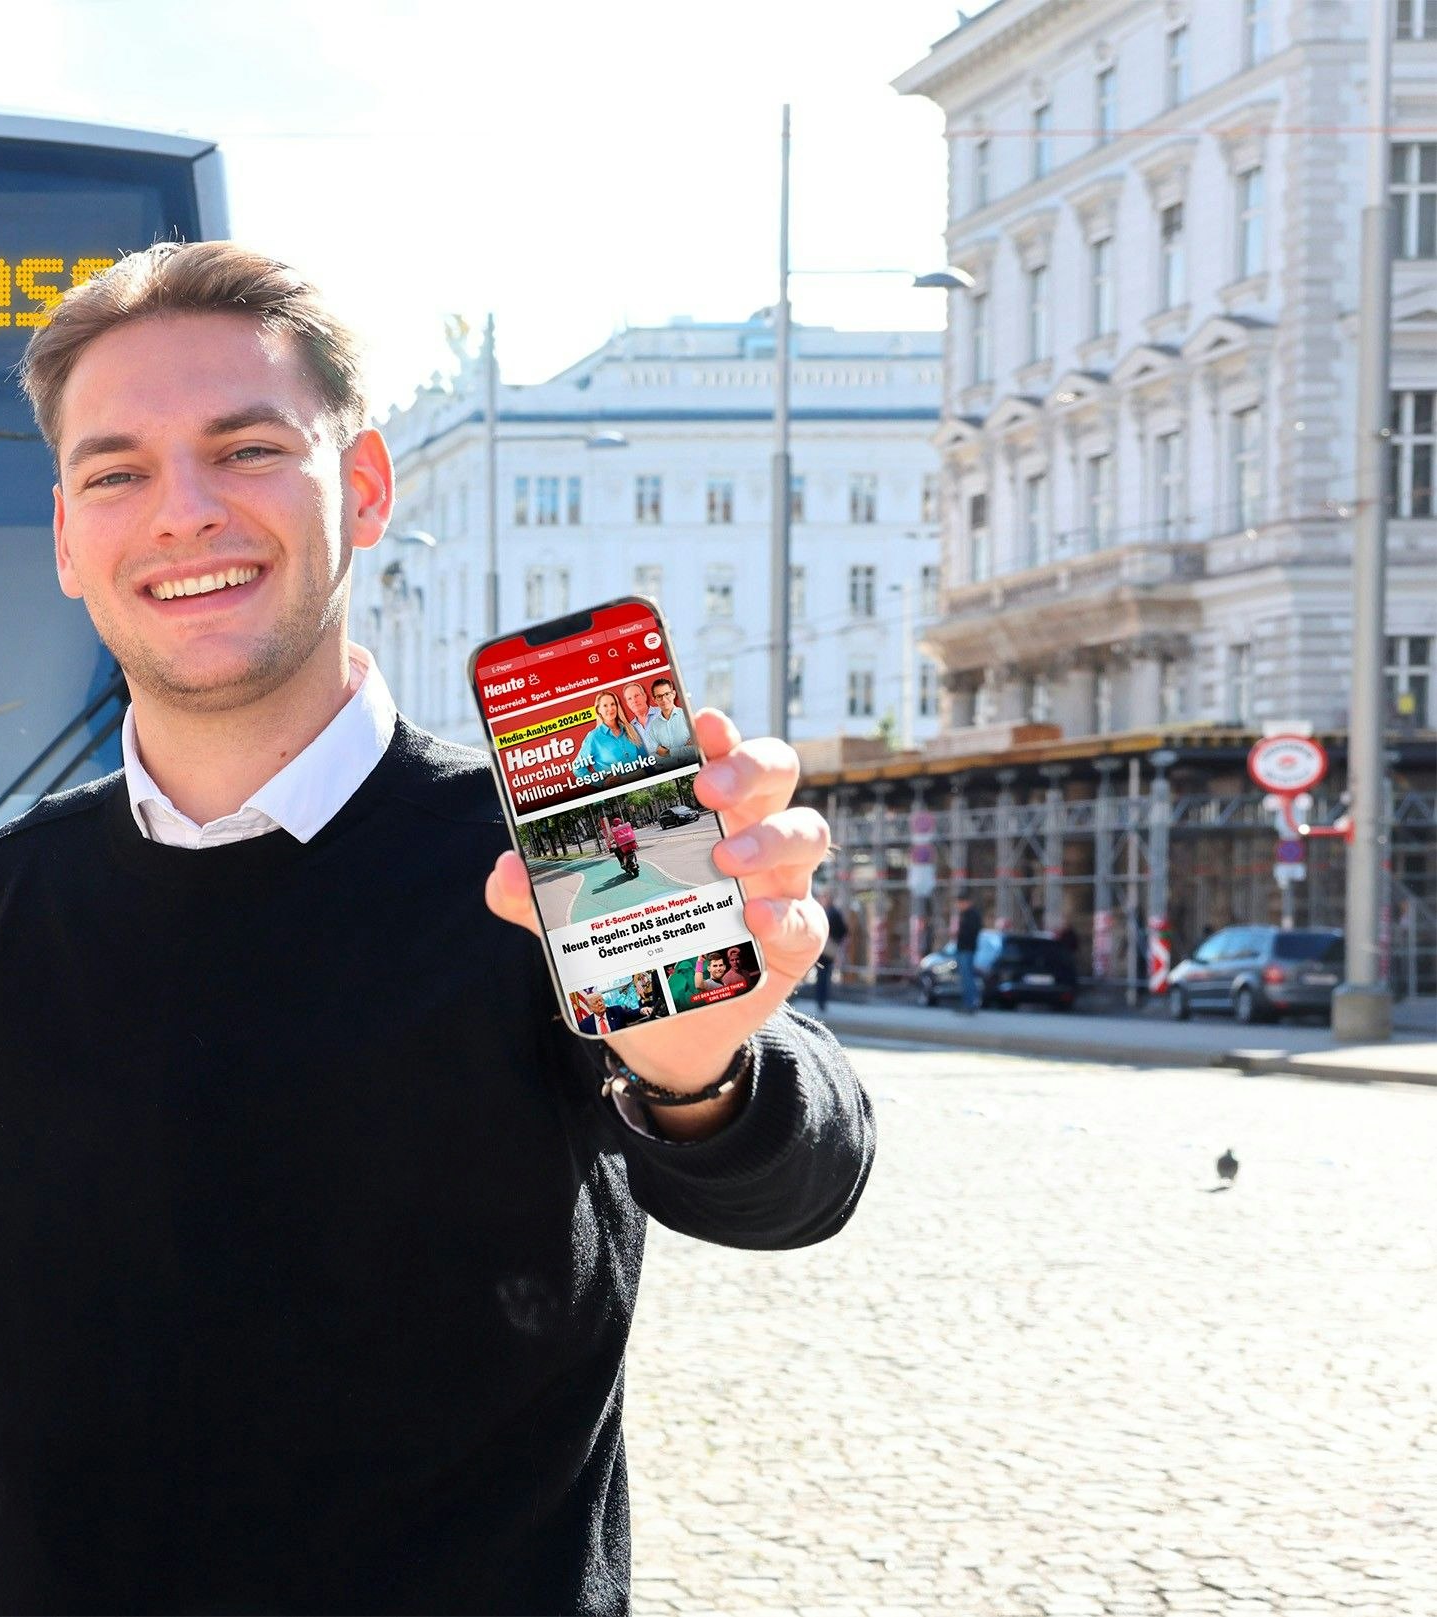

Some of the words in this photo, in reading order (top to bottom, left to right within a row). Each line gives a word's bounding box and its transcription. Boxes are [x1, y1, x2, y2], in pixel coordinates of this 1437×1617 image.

[631, 657, 661, 671] Neueste
[483, 676, 525, 698] Heute
[488, 696, 527, 714] Österreich
[531, 690, 552, 702] Sport
[555, 676, 599, 694] Nachrichten
[499, 723, 557, 746] Media-Analyse
[558, 711, 592, 728] 2024/25
[505, 736, 575, 772] Heute
[512, 753, 595, 788] durchbricht
[515, 755, 657, 805] Million-Leser-Marke
[562, 939, 590, 955] Neue
[591, 927, 630, 946] Regeln:
[631, 919, 654, 934] DAS
[655, 910, 692, 927] ändert
[693, 902, 714, 916] sich
[716, 895, 734, 909] auf
[591, 921, 604, 931] Für
[605, 910, 644, 927] E-Scooter,
[644, 903, 668, 916] Bikes,
[668, 894, 697, 909] Mopeds
[598, 934, 662, 959] Österreichs
[663, 921, 706, 940] Straßen
